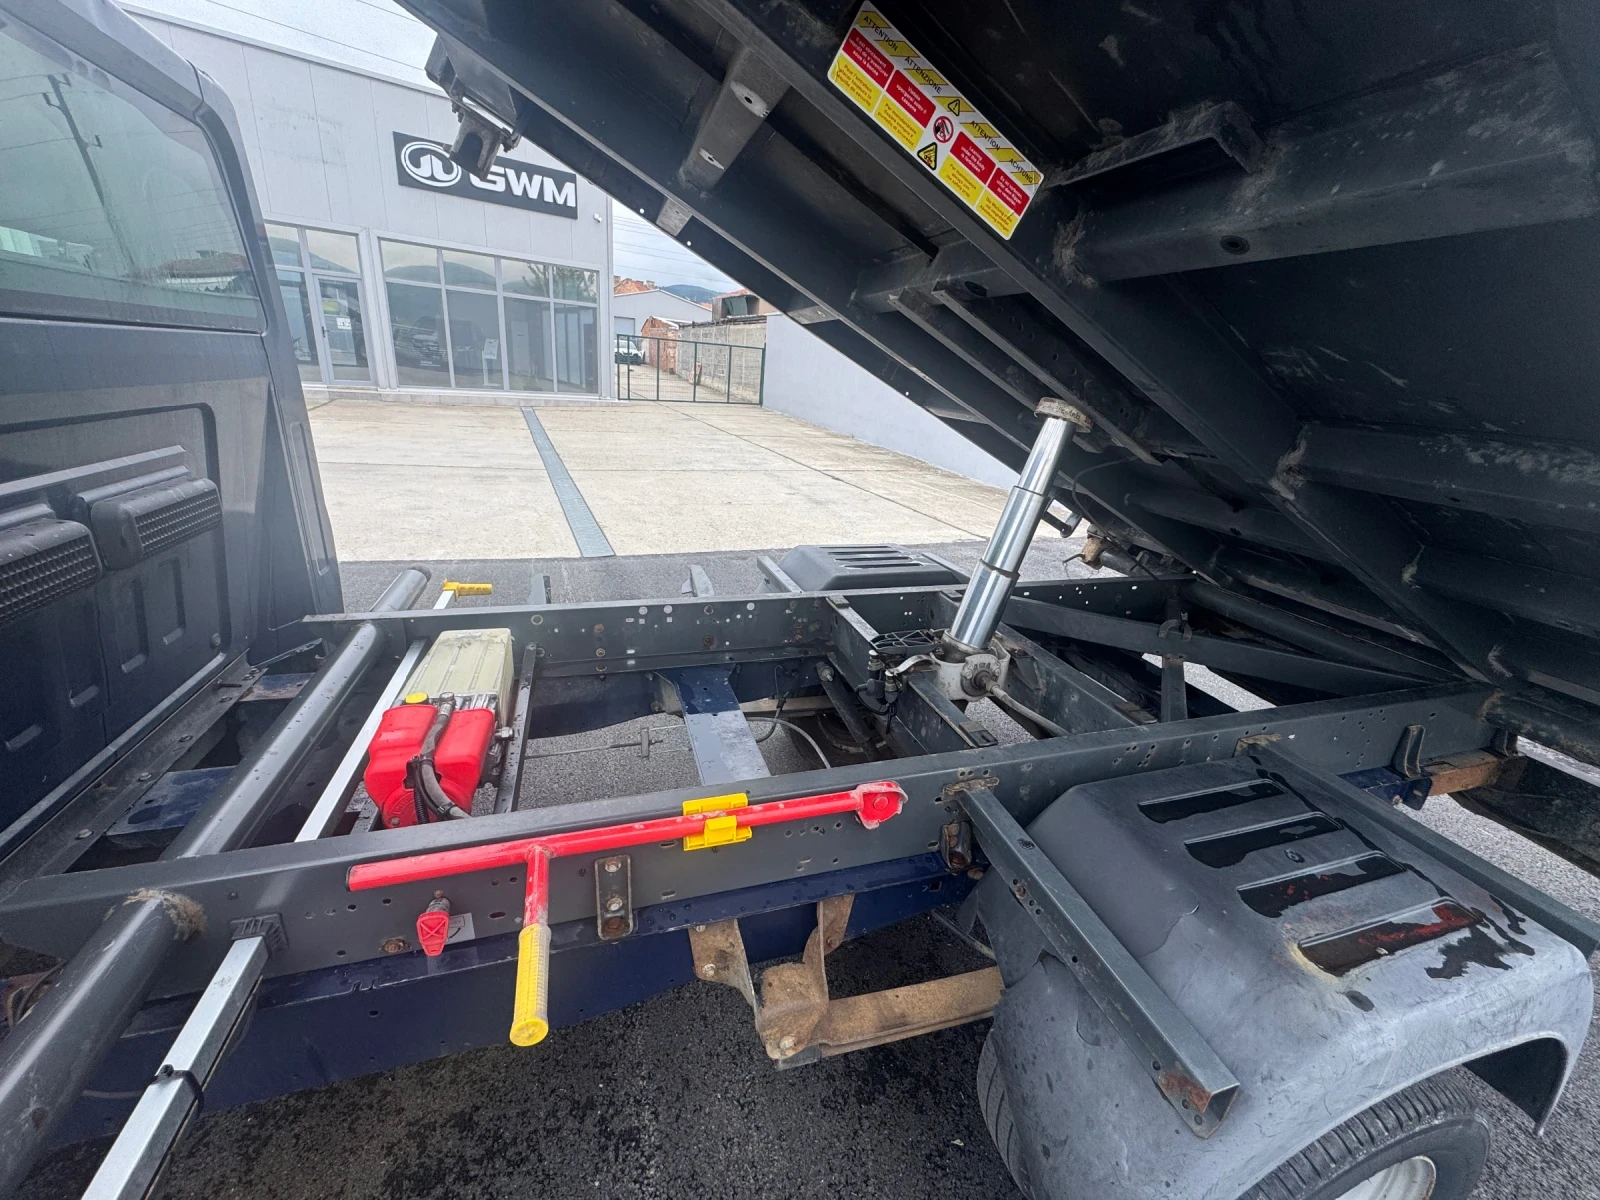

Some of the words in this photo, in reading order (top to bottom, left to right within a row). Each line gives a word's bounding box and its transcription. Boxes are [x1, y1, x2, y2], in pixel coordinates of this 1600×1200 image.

[863, 14, 898, 51] ATTENTION
[904, 54, 942, 94] ATTENZIONE
[970, 119, 1000, 151] ATTENTION
[1008, 157, 1033, 183] ACHTUNG
